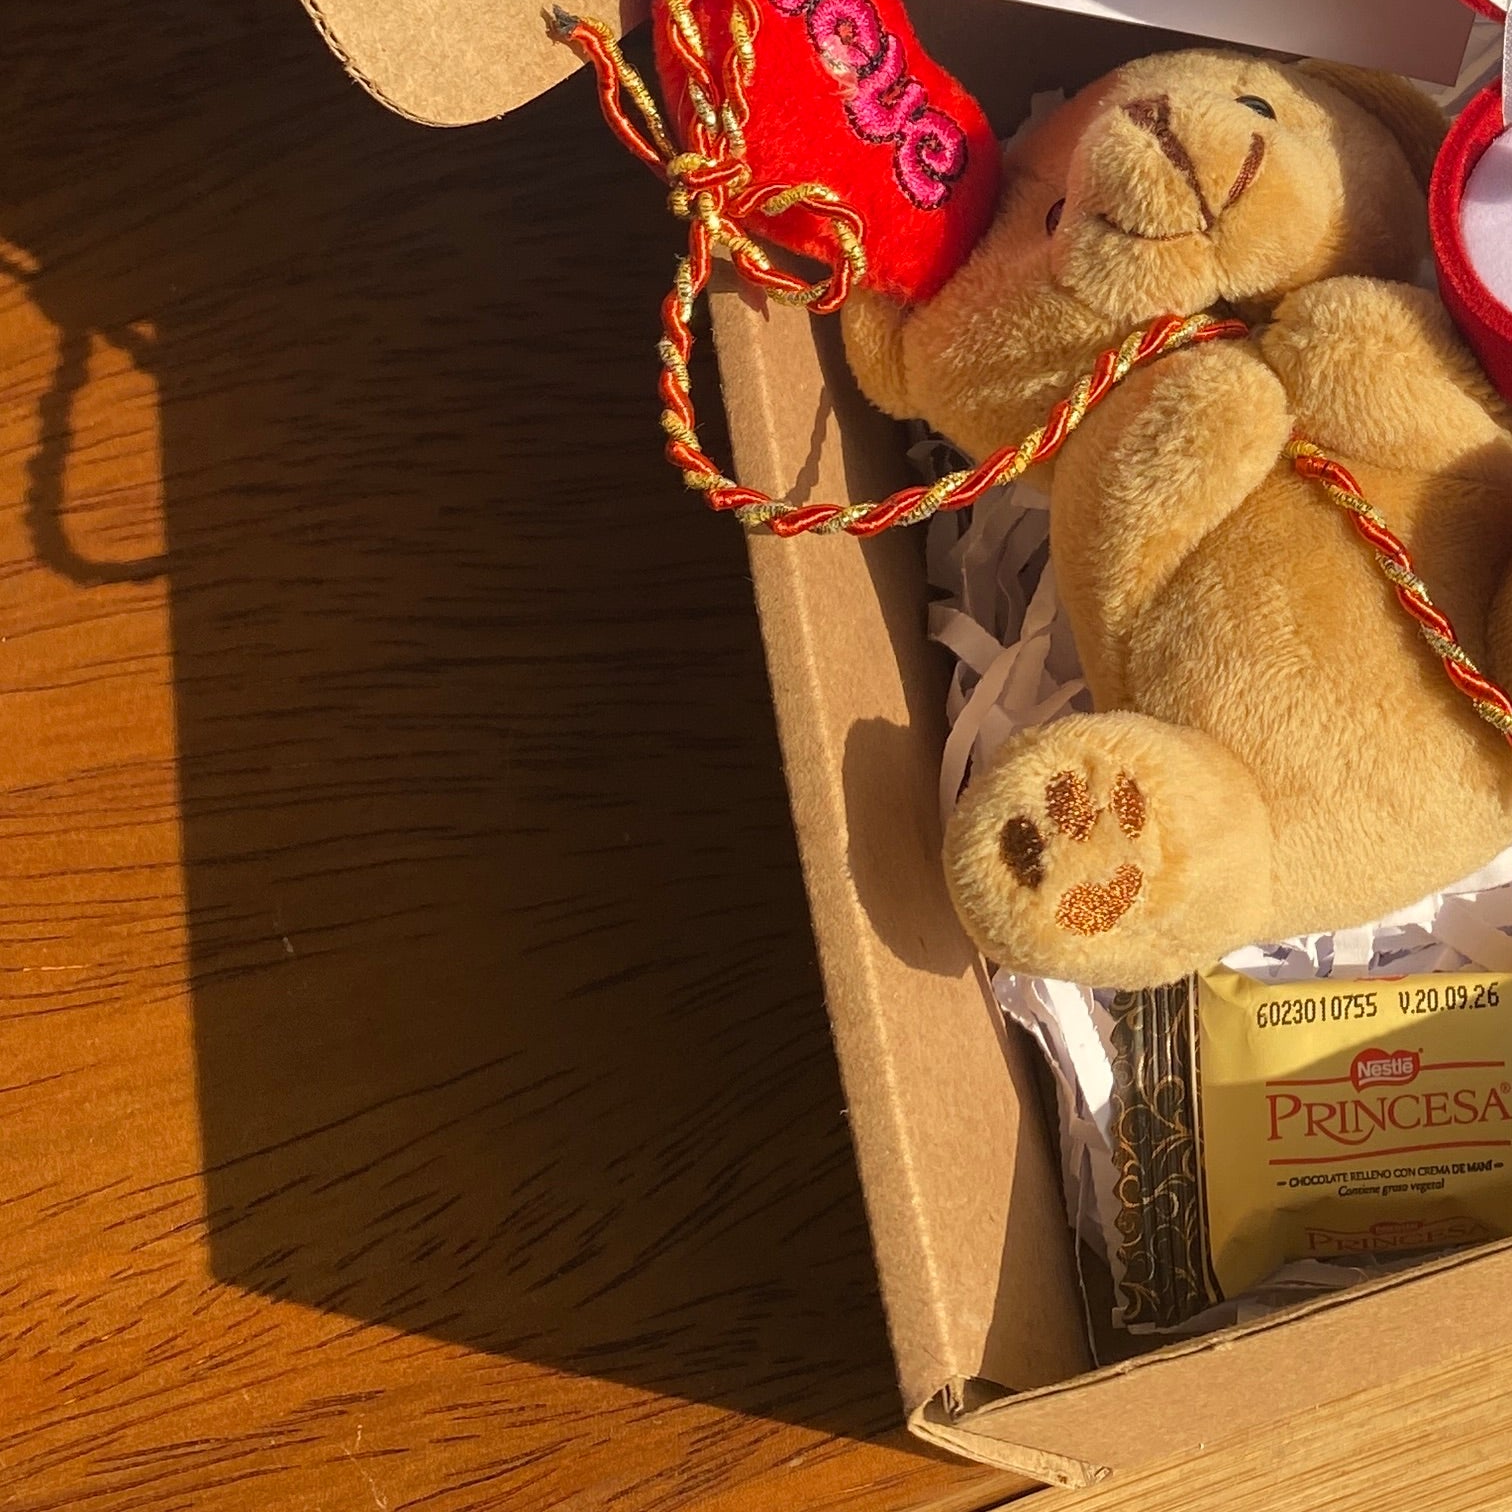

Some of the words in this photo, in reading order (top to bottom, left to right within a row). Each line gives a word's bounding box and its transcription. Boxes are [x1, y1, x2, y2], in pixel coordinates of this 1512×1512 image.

[1257, 992, 1377, 1028] 6023010755
[1399, 982, 1499, 1015] V.20.09.26
[1357, 1056, 1414, 1078] Nestlé
[1265, 1088, 1512, 1145] PRINCESA
[1289, 1171, 1349, 1188] CHOCOLATE
[1350, 1169, 1392, 1181] RELLENO
[1393, 1167, 1415, 1178] CON
[1418, 1165, 1450, 1176] CREMA
[1452, 1164, 1466, 1175] DE
[1338, 1183, 1381, 1197] Contiene
[1410, 1178, 1445, 1194] vegetal
